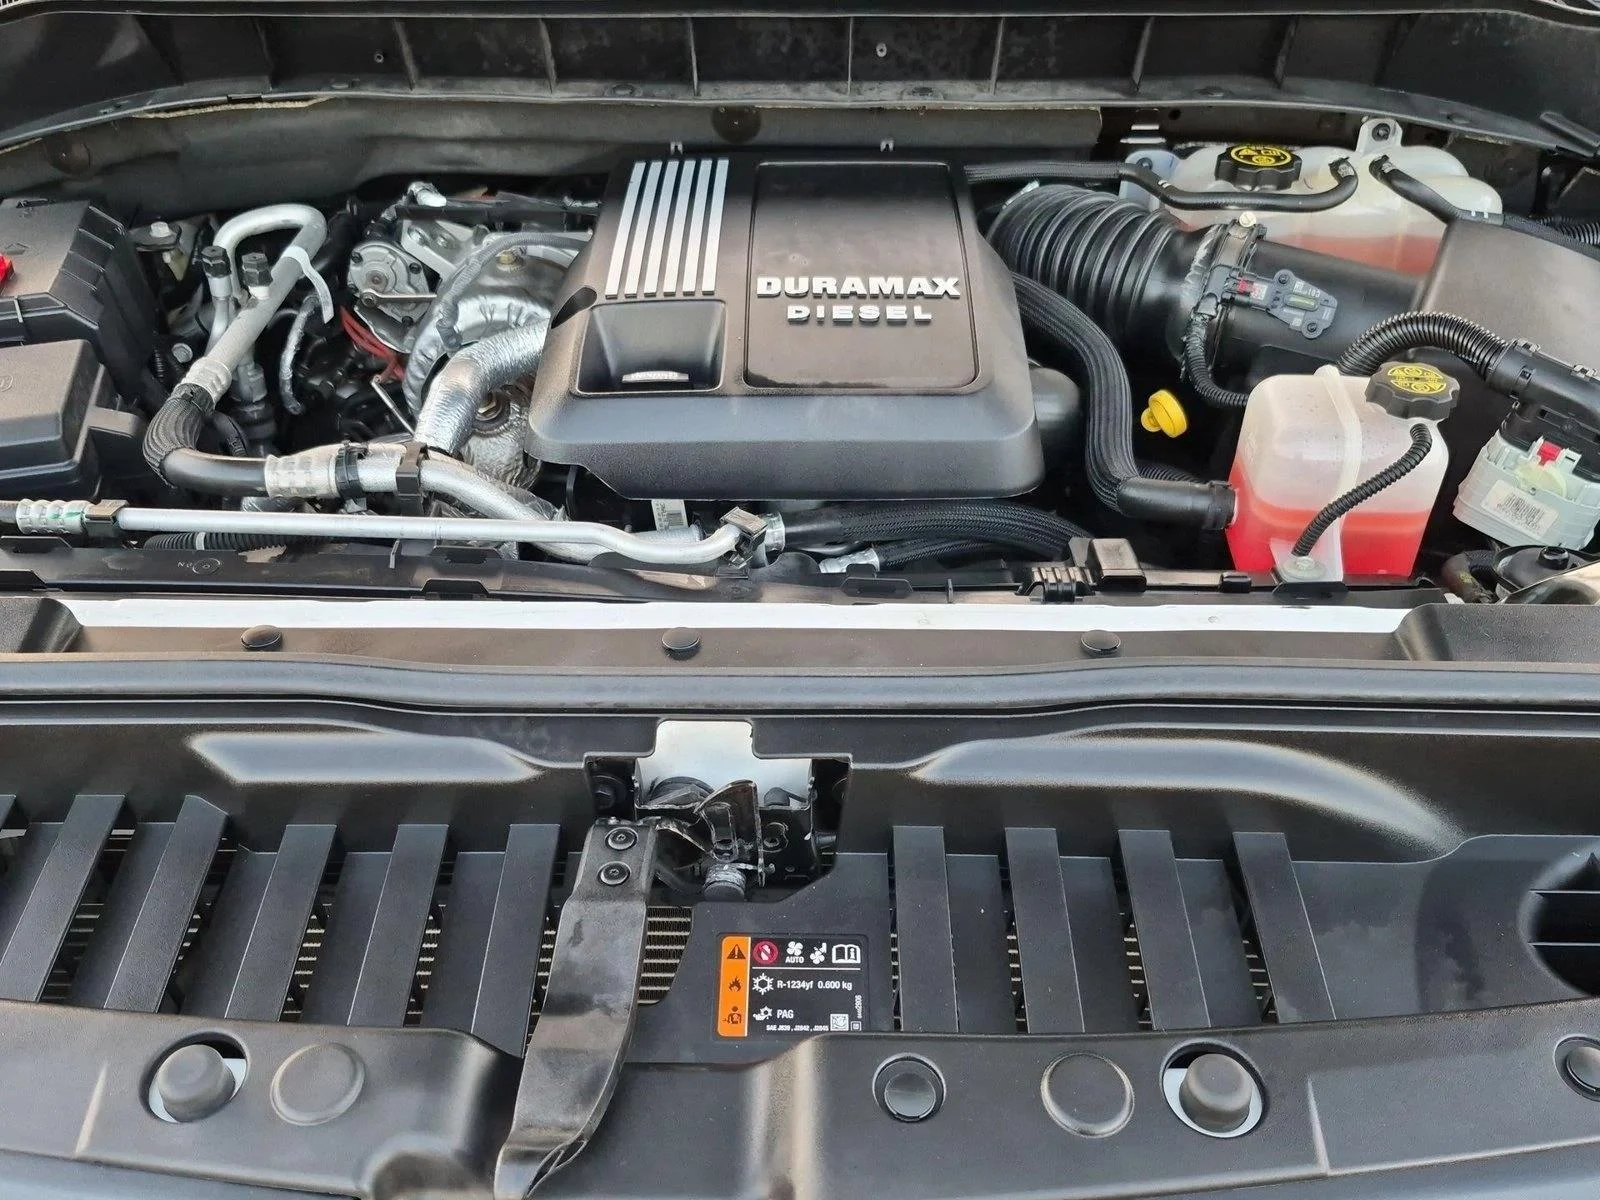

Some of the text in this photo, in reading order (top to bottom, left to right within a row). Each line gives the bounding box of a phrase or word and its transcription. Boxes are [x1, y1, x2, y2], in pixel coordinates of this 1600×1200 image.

[757, 276, 961, 299] DURAMAX
[787, 305, 932, 324] DIESEL
[785, 956, 804, 964] AUTO
[777, 980, 852, 991] R-1234yf 0.600 kg
[777, 1009, 794, 1019] PAG
